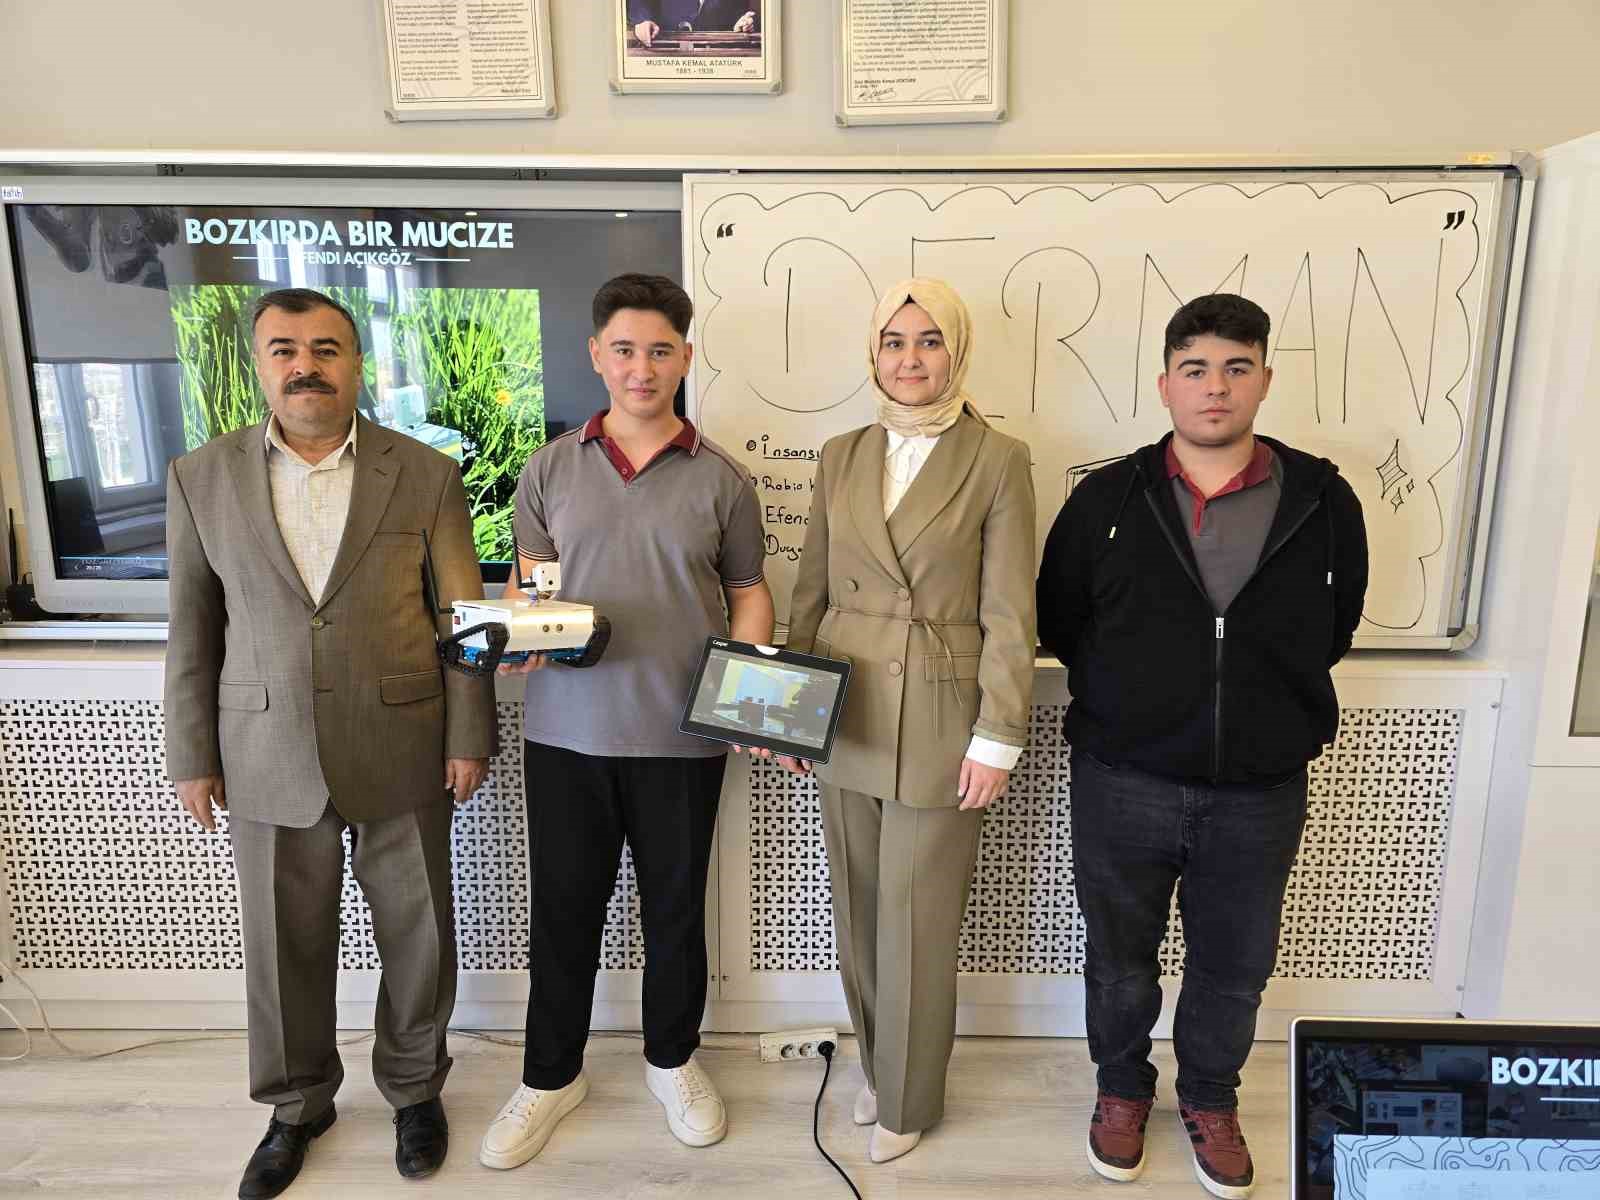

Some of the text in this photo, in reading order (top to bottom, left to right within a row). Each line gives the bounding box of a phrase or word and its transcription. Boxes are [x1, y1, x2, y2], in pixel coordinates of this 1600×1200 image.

[646, 59, 680, 67] MUSTAFA
[682, 59, 708, 67] KEMAL
[185, 218, 342, 246] BOZKIRDA
[344, 247, 412, 268] AÇIKGÖZ
